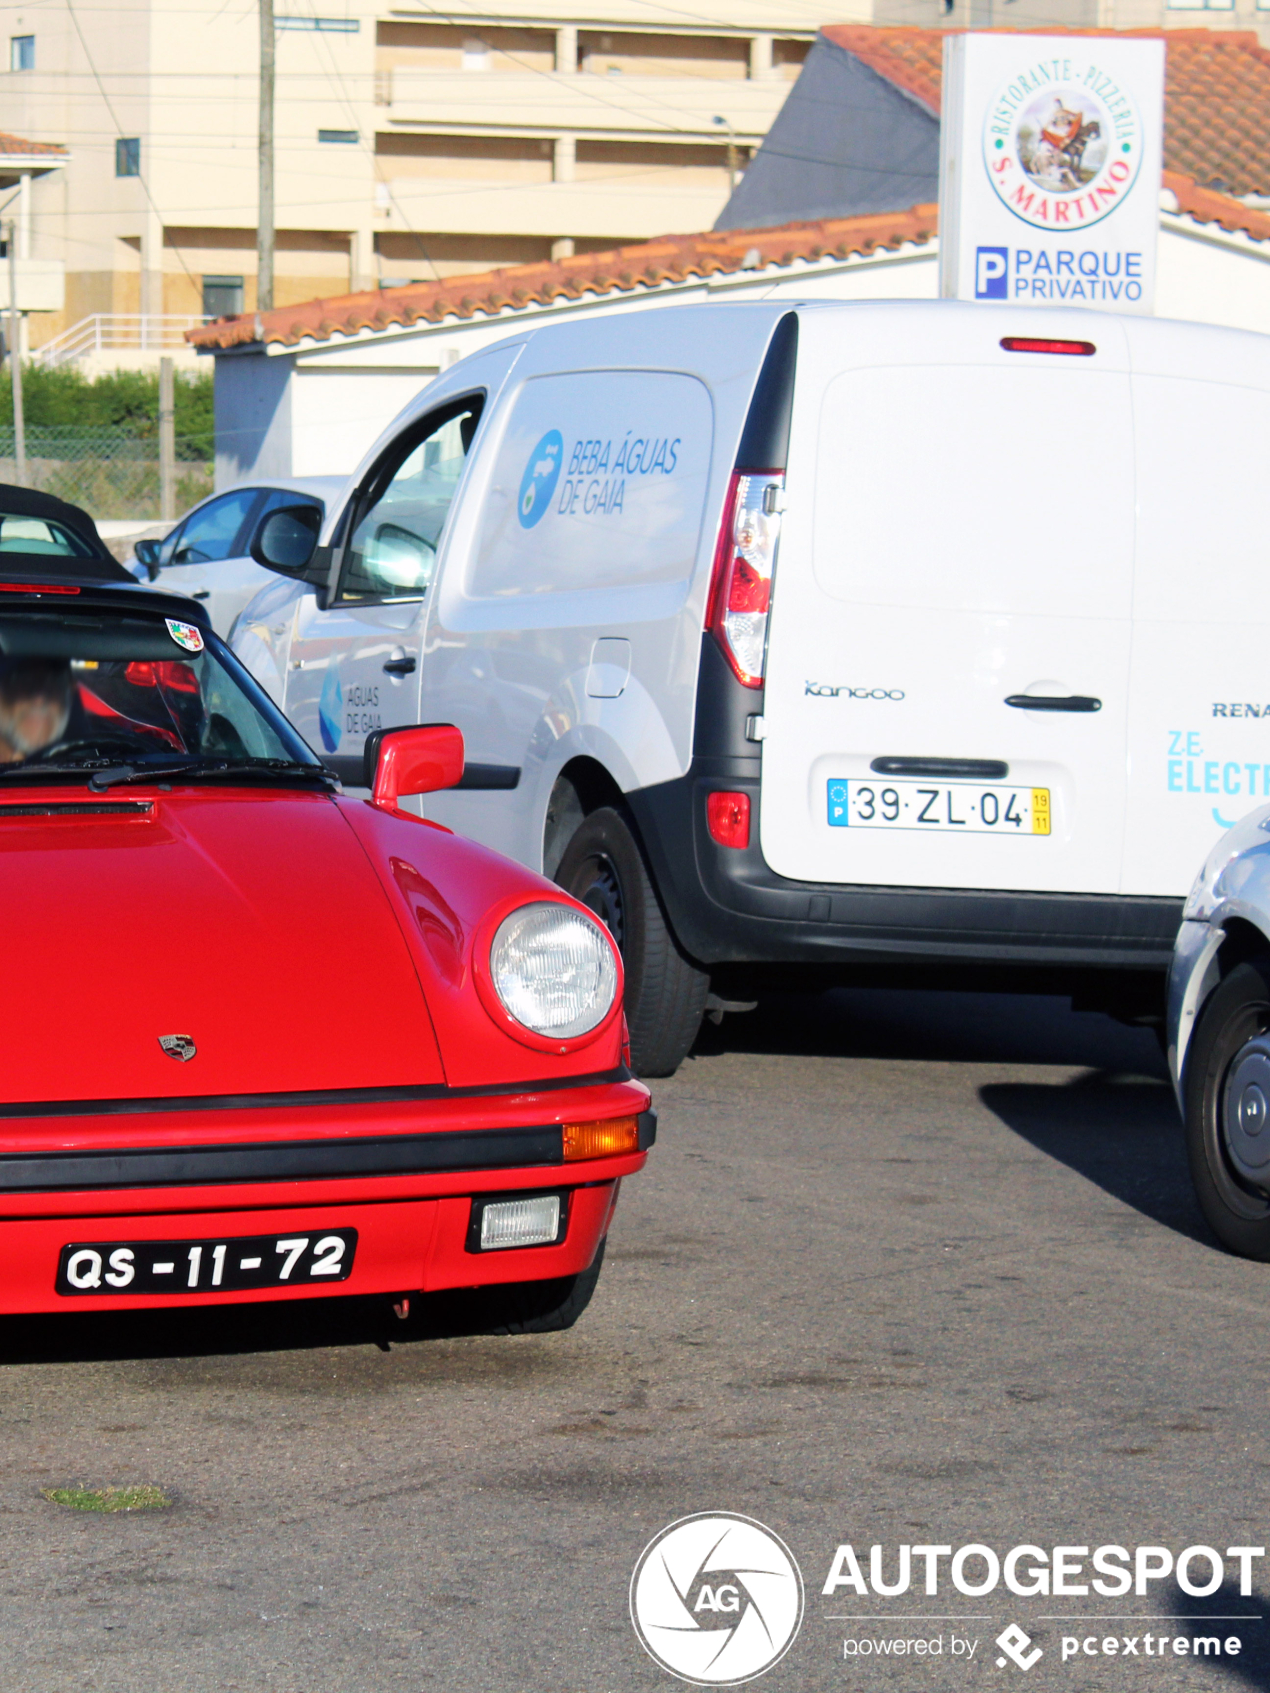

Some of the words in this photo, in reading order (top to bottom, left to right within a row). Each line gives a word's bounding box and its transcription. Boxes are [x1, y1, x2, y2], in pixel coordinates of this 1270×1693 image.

[990, 59, 1071, 136] RISTORANTE
[1083, 65, 1135, 140] PIZZERIA
[992, 157, 1012, 186] S.
[1010, 160, 1130, 222] MARTINO
[1015, 249, 1143, 278] PARQUE
[1015, 277, 1143, 301] PRIVATIVO
[567, 439, 612, 476] BEBA
[611, 430, 682, 475] ÁGUAS
[557, 479, 584, 515] DE
[583, 478, 626, 515] GAIA
[346, 713, 359, 733] DE
[360, 713, 382, 733] GAIA
[1167, 730, 1205, 757] Z.E.
[1034, 794, 1048, 807] 19
[1035, 817, 1048, 829] 11
